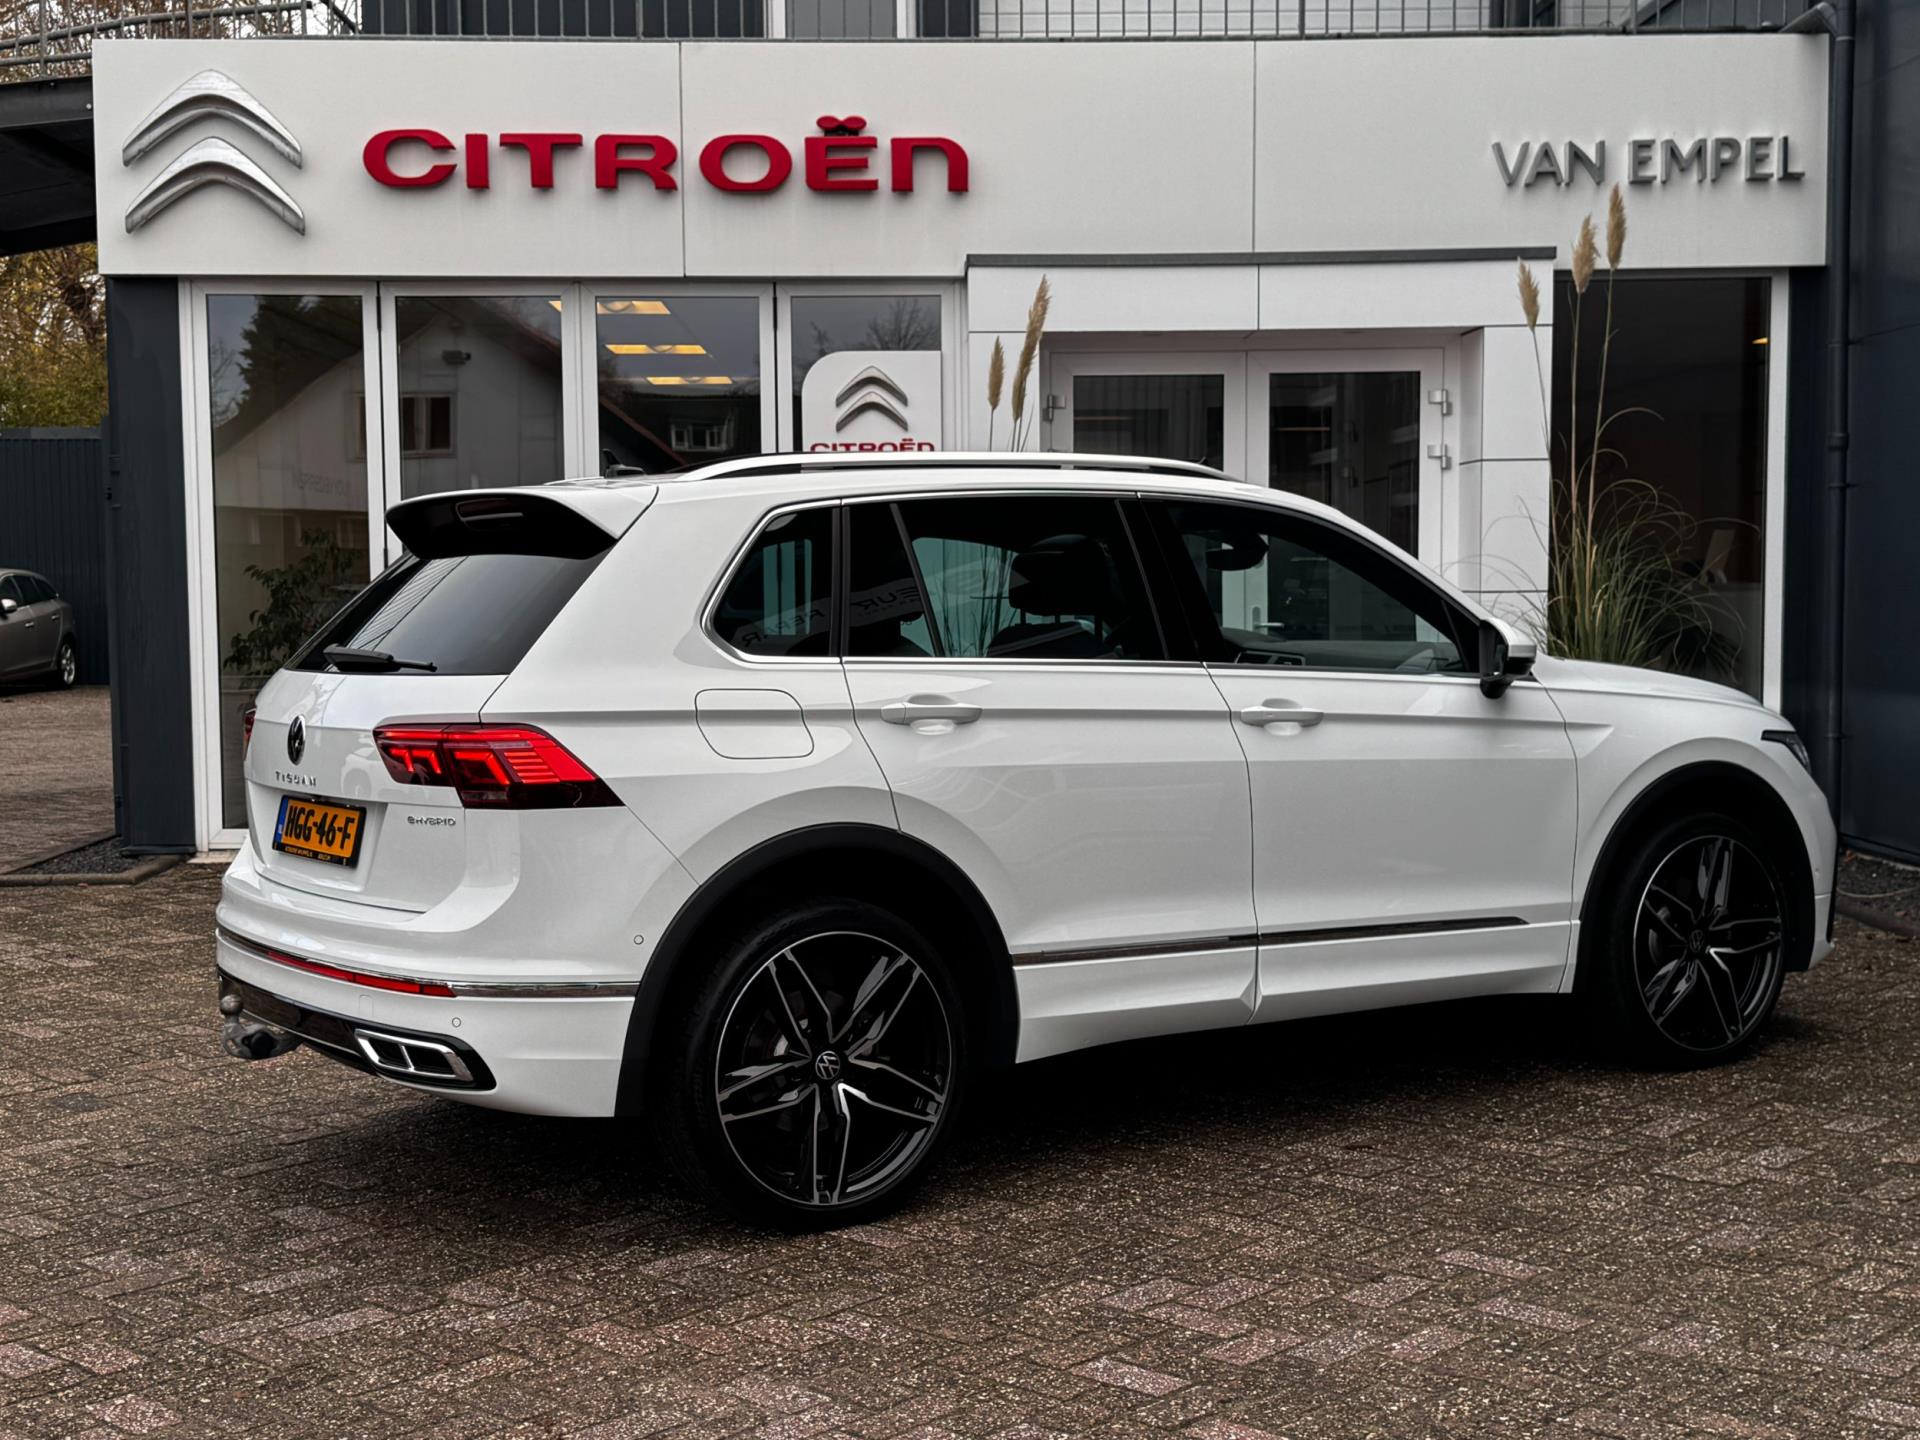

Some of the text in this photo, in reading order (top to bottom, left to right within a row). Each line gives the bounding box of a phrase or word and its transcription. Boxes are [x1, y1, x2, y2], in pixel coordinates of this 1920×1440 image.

[363, 115, 969, 193] CITROËN
[1491, 136, 1806, 187] VAN EMPEL
